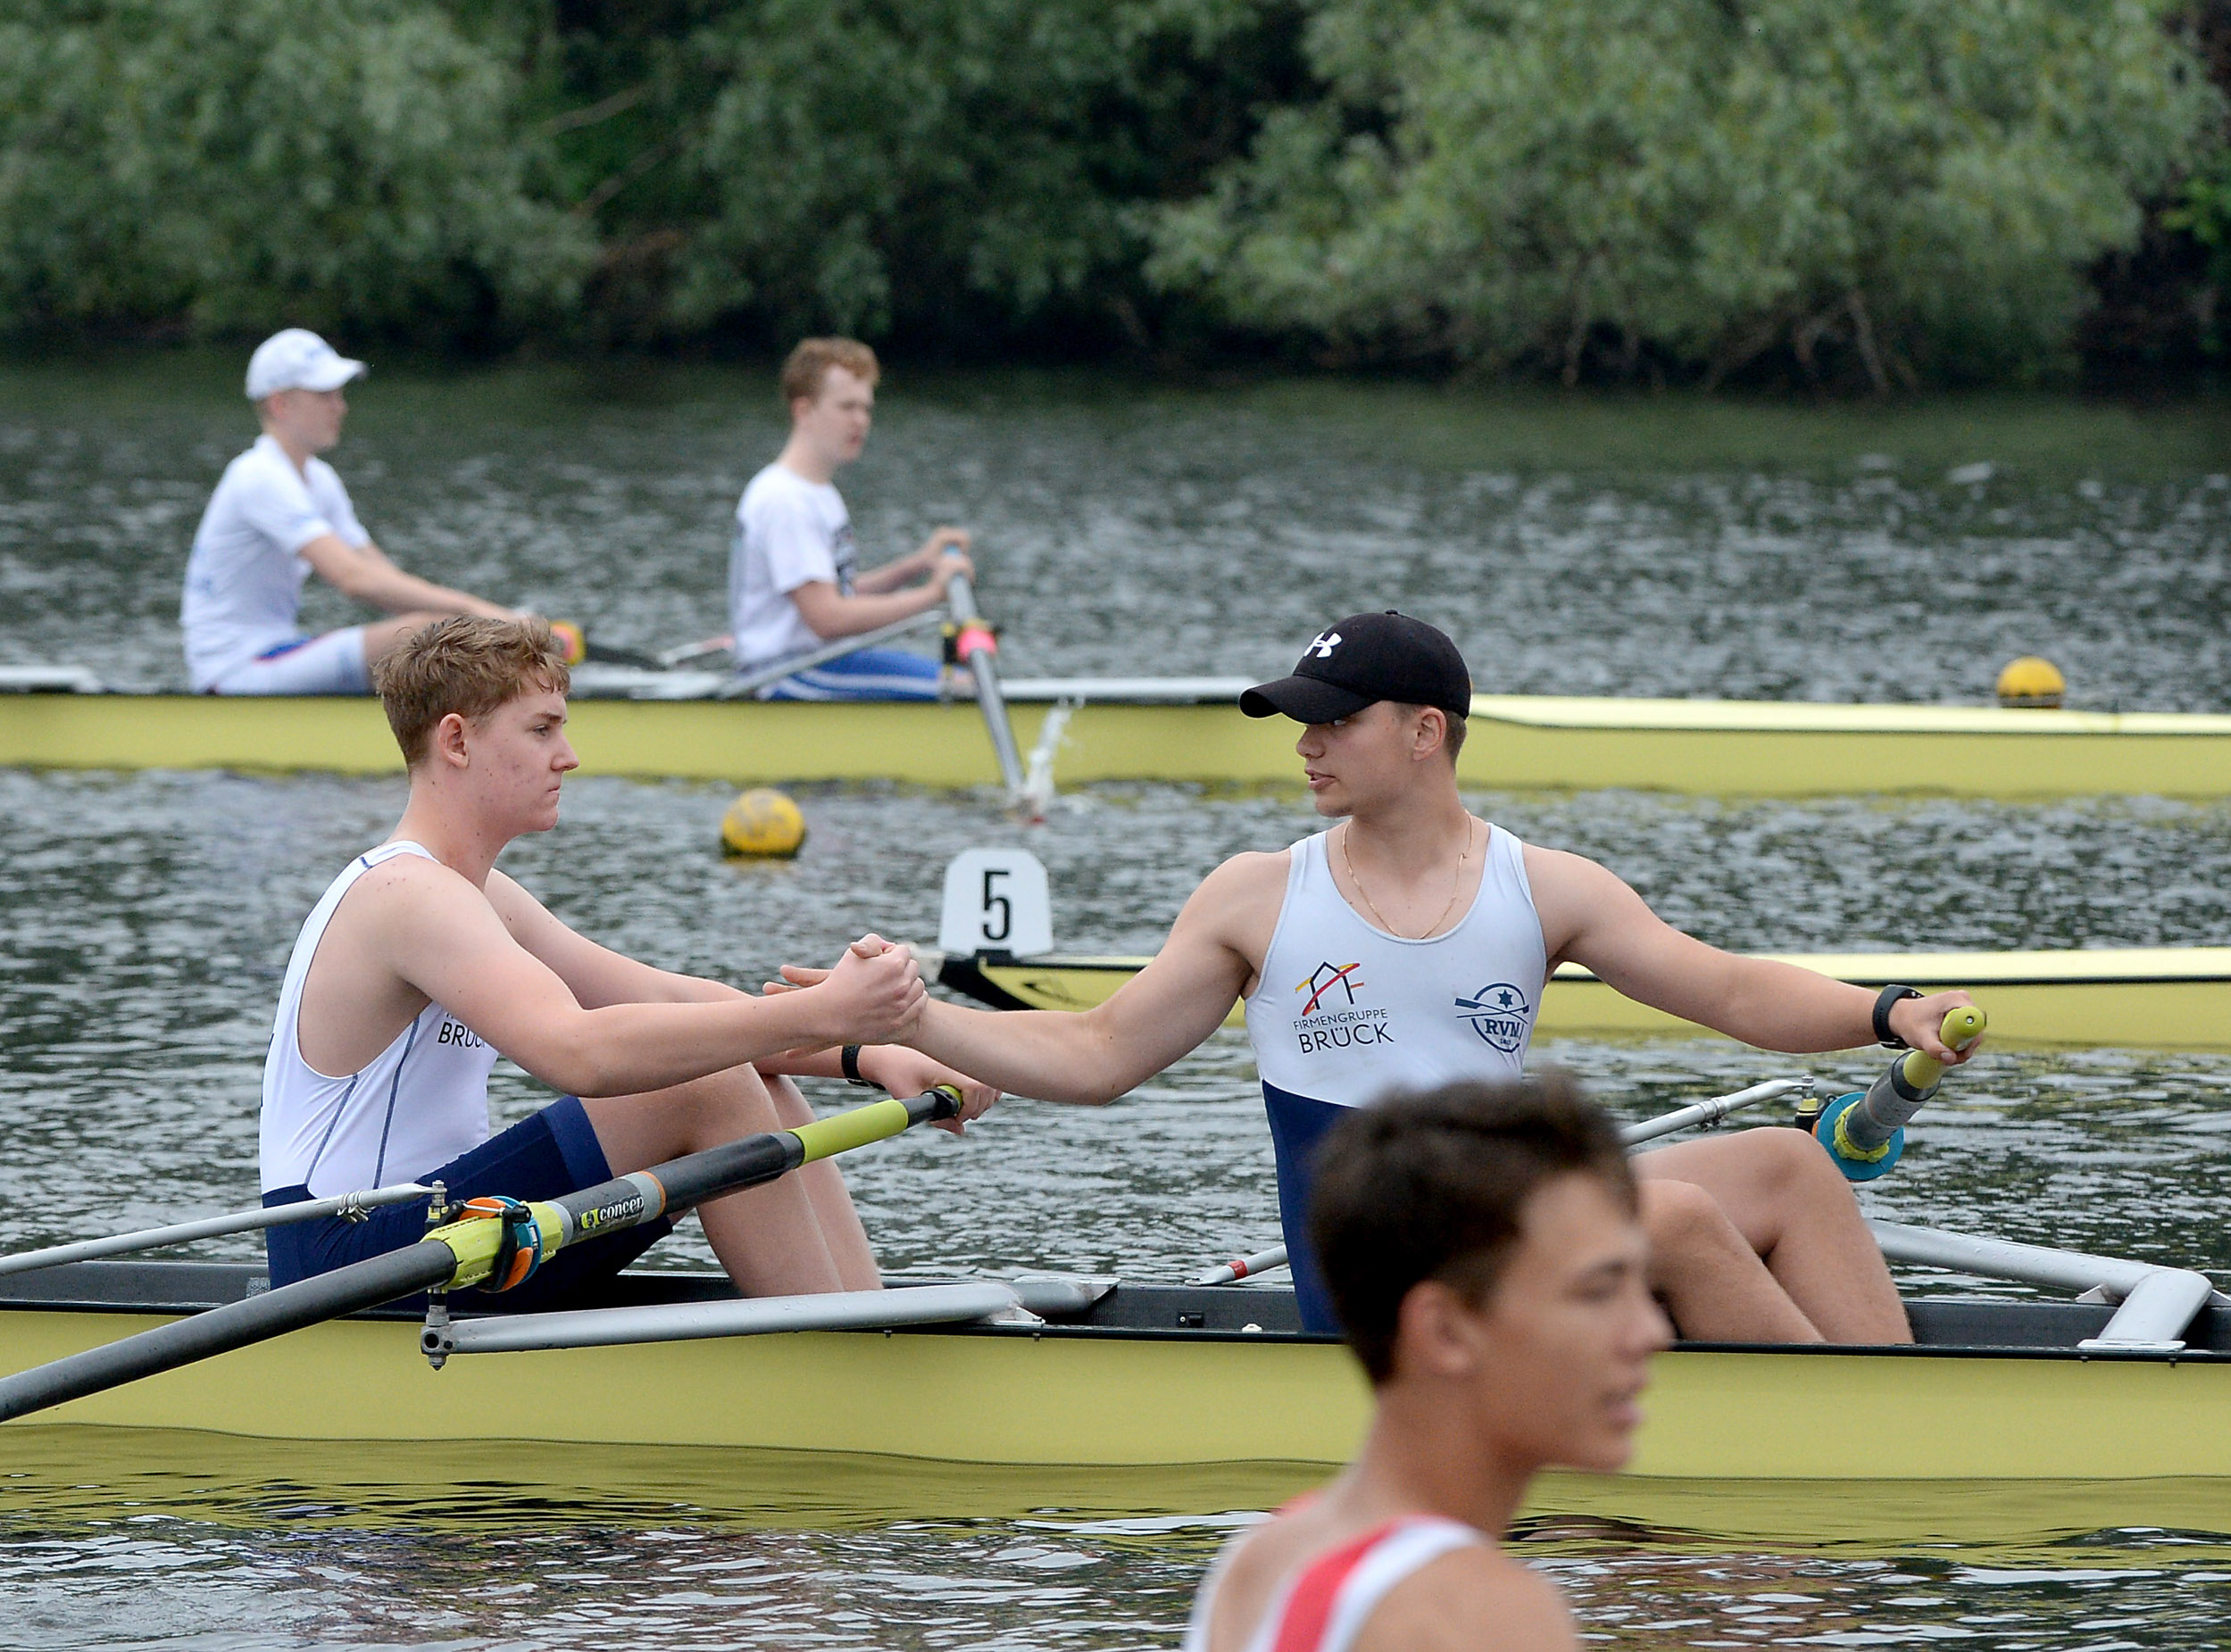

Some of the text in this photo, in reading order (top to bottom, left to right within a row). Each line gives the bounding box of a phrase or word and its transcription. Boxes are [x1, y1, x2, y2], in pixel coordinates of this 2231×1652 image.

[983, 870, 1011, 941] 5
[1293, 1009, 1388, 1030] FIRMENGRUPPE
[1298, 1022, 1394, 1054] BRÜCK
